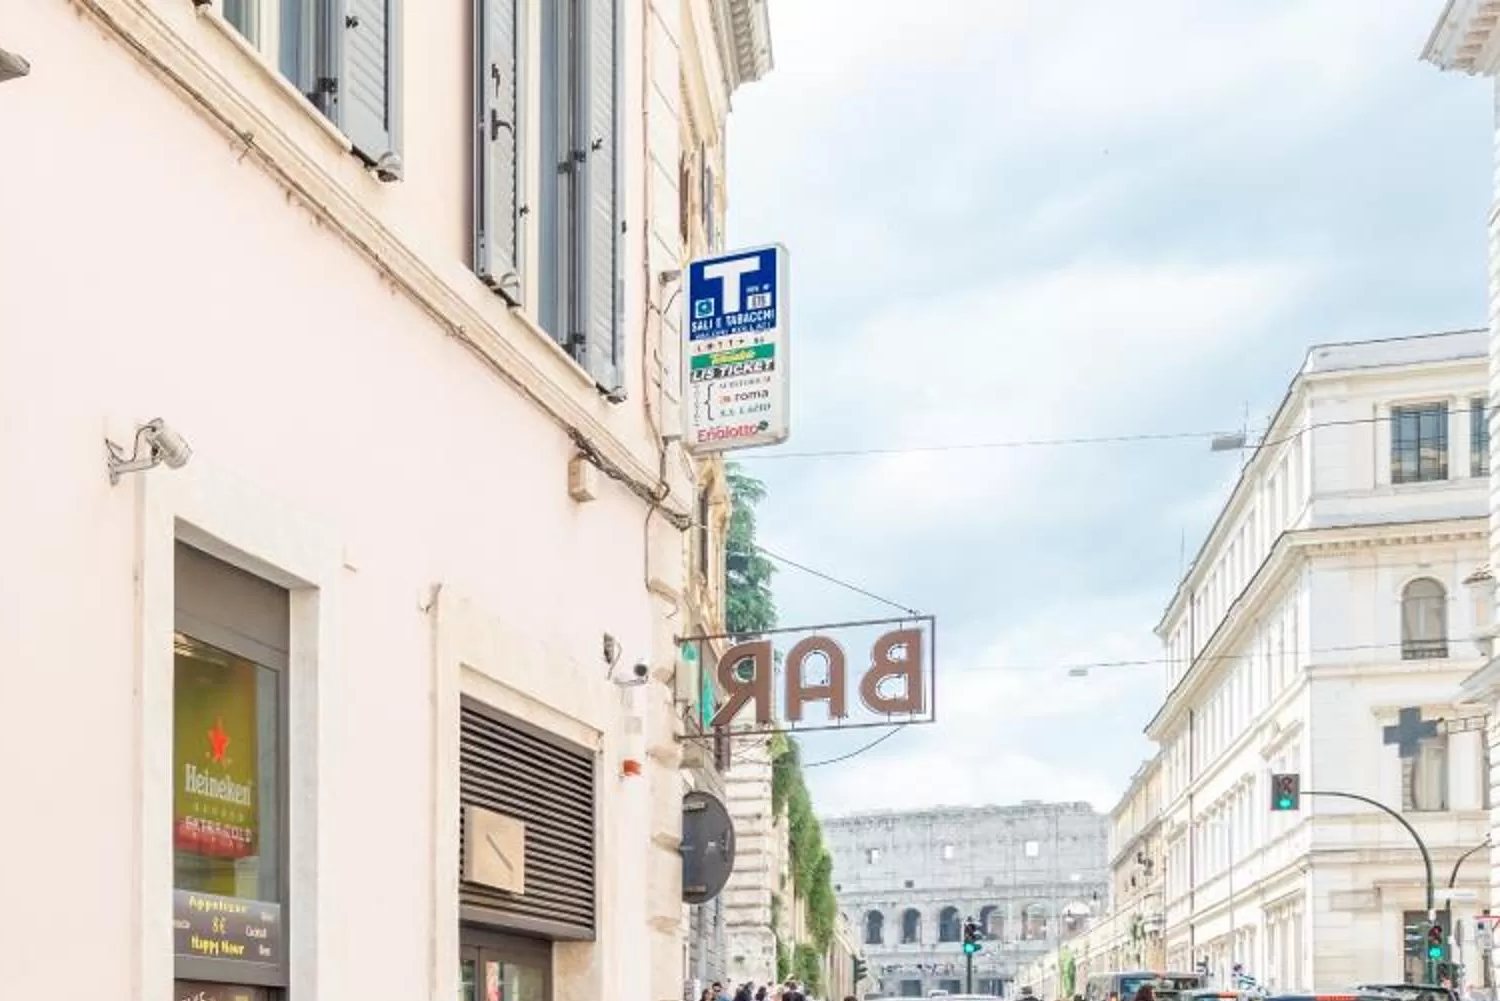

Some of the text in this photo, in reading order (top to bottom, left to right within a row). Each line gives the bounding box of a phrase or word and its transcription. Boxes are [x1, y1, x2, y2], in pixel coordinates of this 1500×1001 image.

[691, 318, 713, 332] SALI
[725, 308, 775, 327] TABACCHI
[735, 389, 769, 402] roma
[185, 763, 251, 806] Heineken
[191, 935, 219, 956] Happy
[221, 940, 245, 955] Hour
